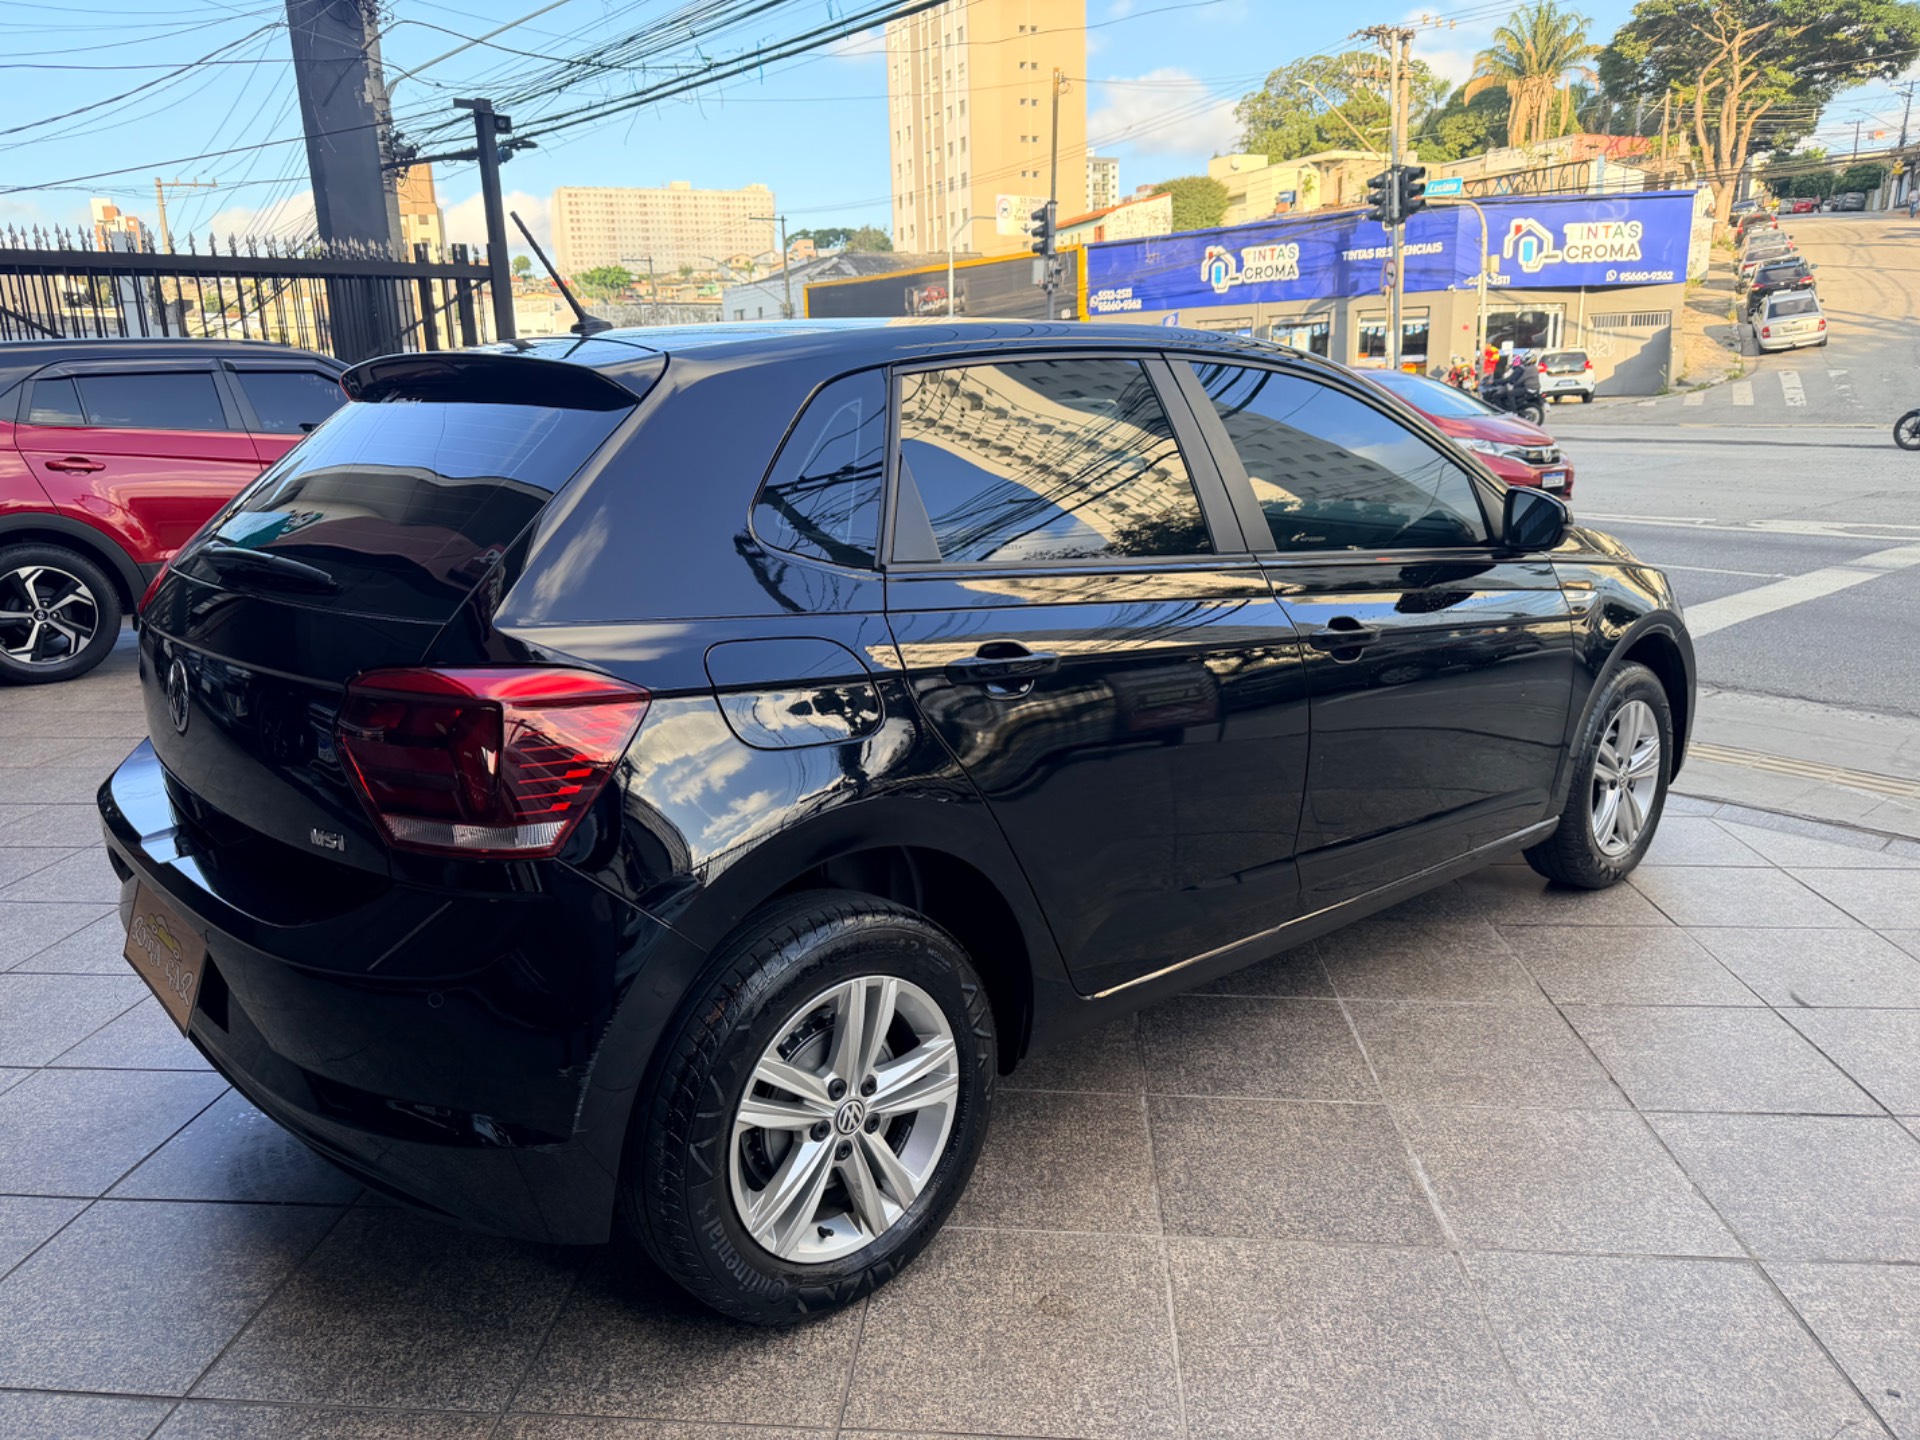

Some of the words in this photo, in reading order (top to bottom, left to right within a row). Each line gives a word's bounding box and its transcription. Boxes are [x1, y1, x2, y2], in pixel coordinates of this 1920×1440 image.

[1566, 223, 1639, 241] TINTAS
[1244, 246, 1296, 264] TINTAS
[1342, 248, 1374, 261] TINTAS
[1375, 241, 1443, 259] RESENCIAIS
[1566, 243, 1639, 259] CROMA
[1244, 263, 1297, 281] CROMA
